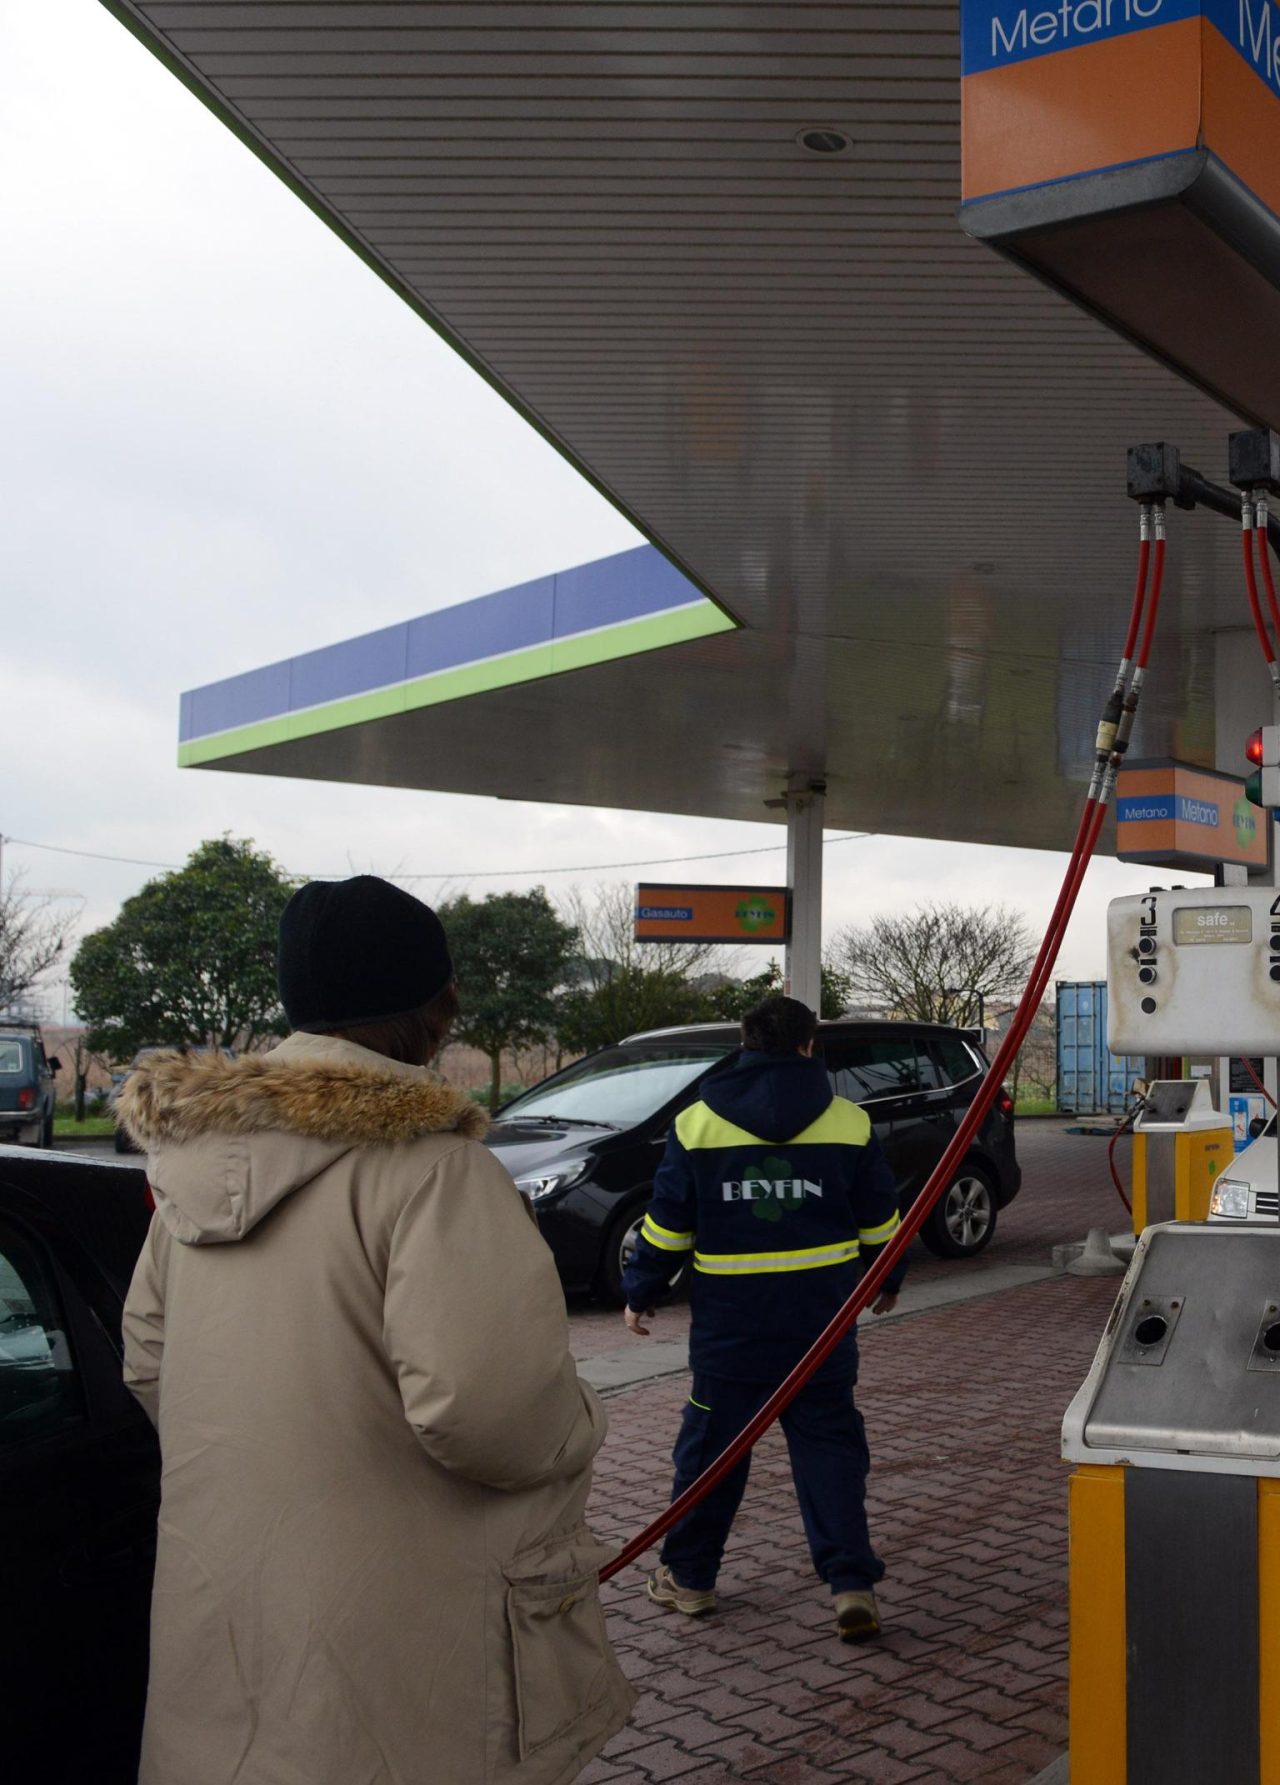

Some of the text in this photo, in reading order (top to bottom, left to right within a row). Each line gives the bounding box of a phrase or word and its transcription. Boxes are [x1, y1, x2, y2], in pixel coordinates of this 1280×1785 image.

[1125, 808, 1168, 819] Metano
[1181, 798, 1217, 826] Metano
[641, 907, 688, 919] Gasauto
[1141, 896, 1157, 926] 3
[1197, 912, 1228, 926] safe
[722, 1179, 822, 1201] BEYFIN
